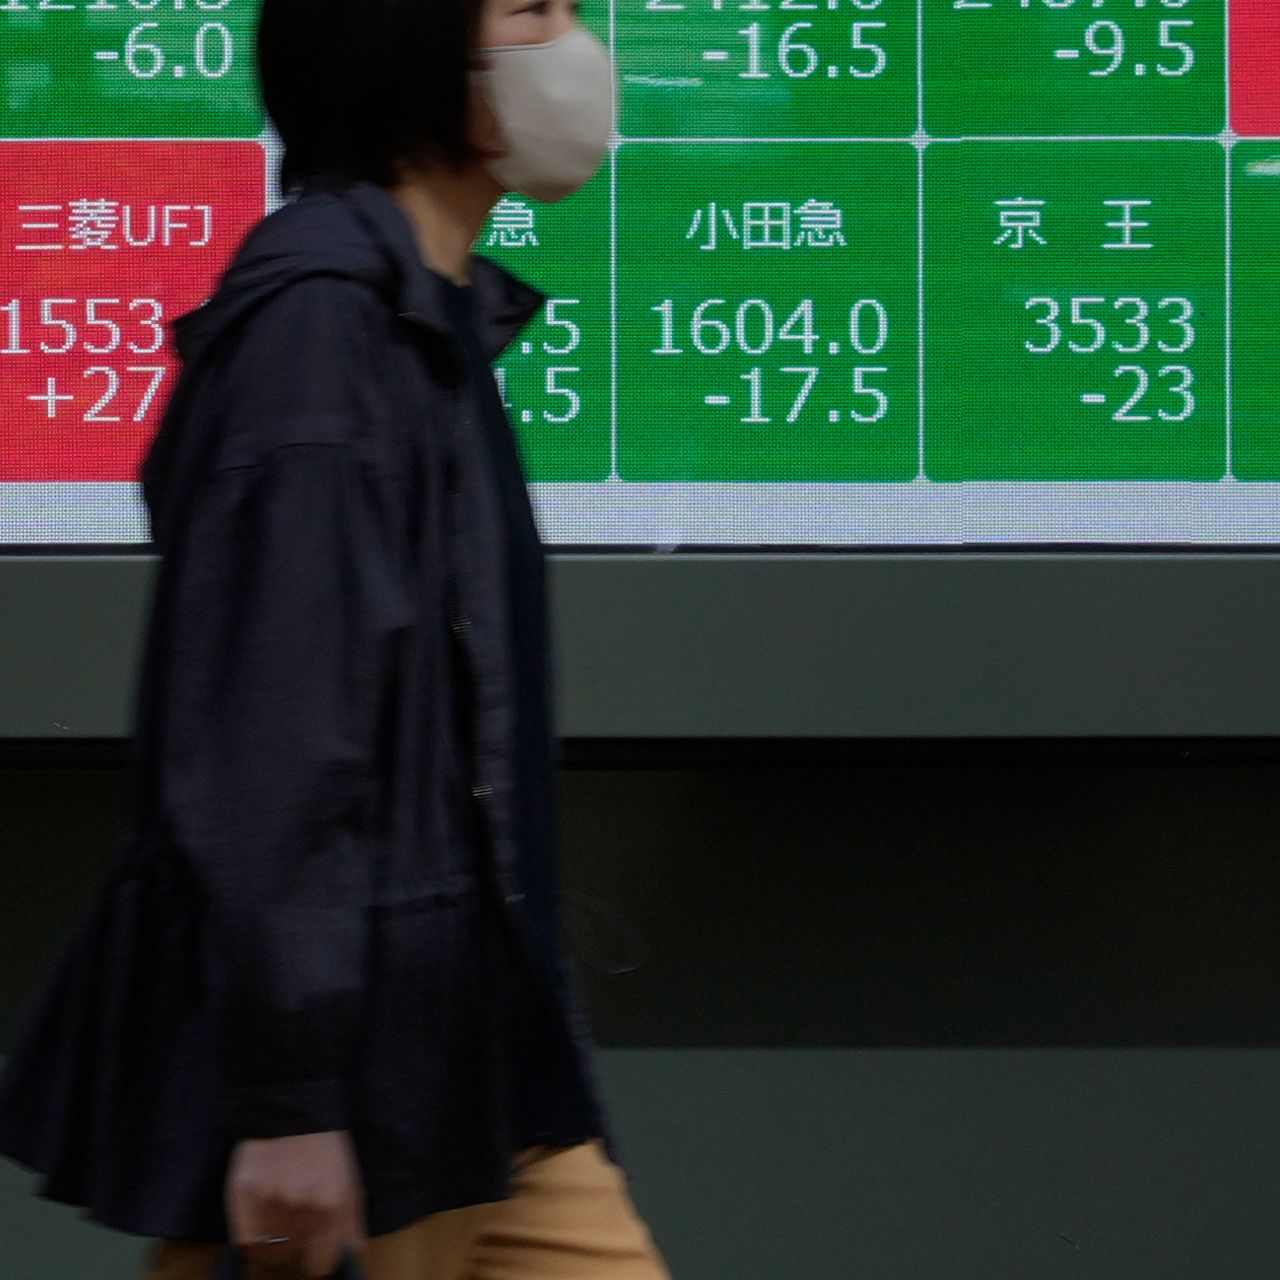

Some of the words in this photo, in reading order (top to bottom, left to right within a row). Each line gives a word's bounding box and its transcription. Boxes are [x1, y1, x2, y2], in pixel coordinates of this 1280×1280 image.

[95, 20, 235, 80] -6.0
[701, 22, 886, 79] -16.5
[1055, 19, 1194, 77] -9.5
[16, 198, 212, 251] 三菱UFJ
[687, 198, 846, 251] 小田急
[654, 298, 888, 355] 1604.0
[1025, 296, 1195, 354] 3533
[705, 366, 888, 424] -17.5
[1081, 364, 1195, 422] -23
